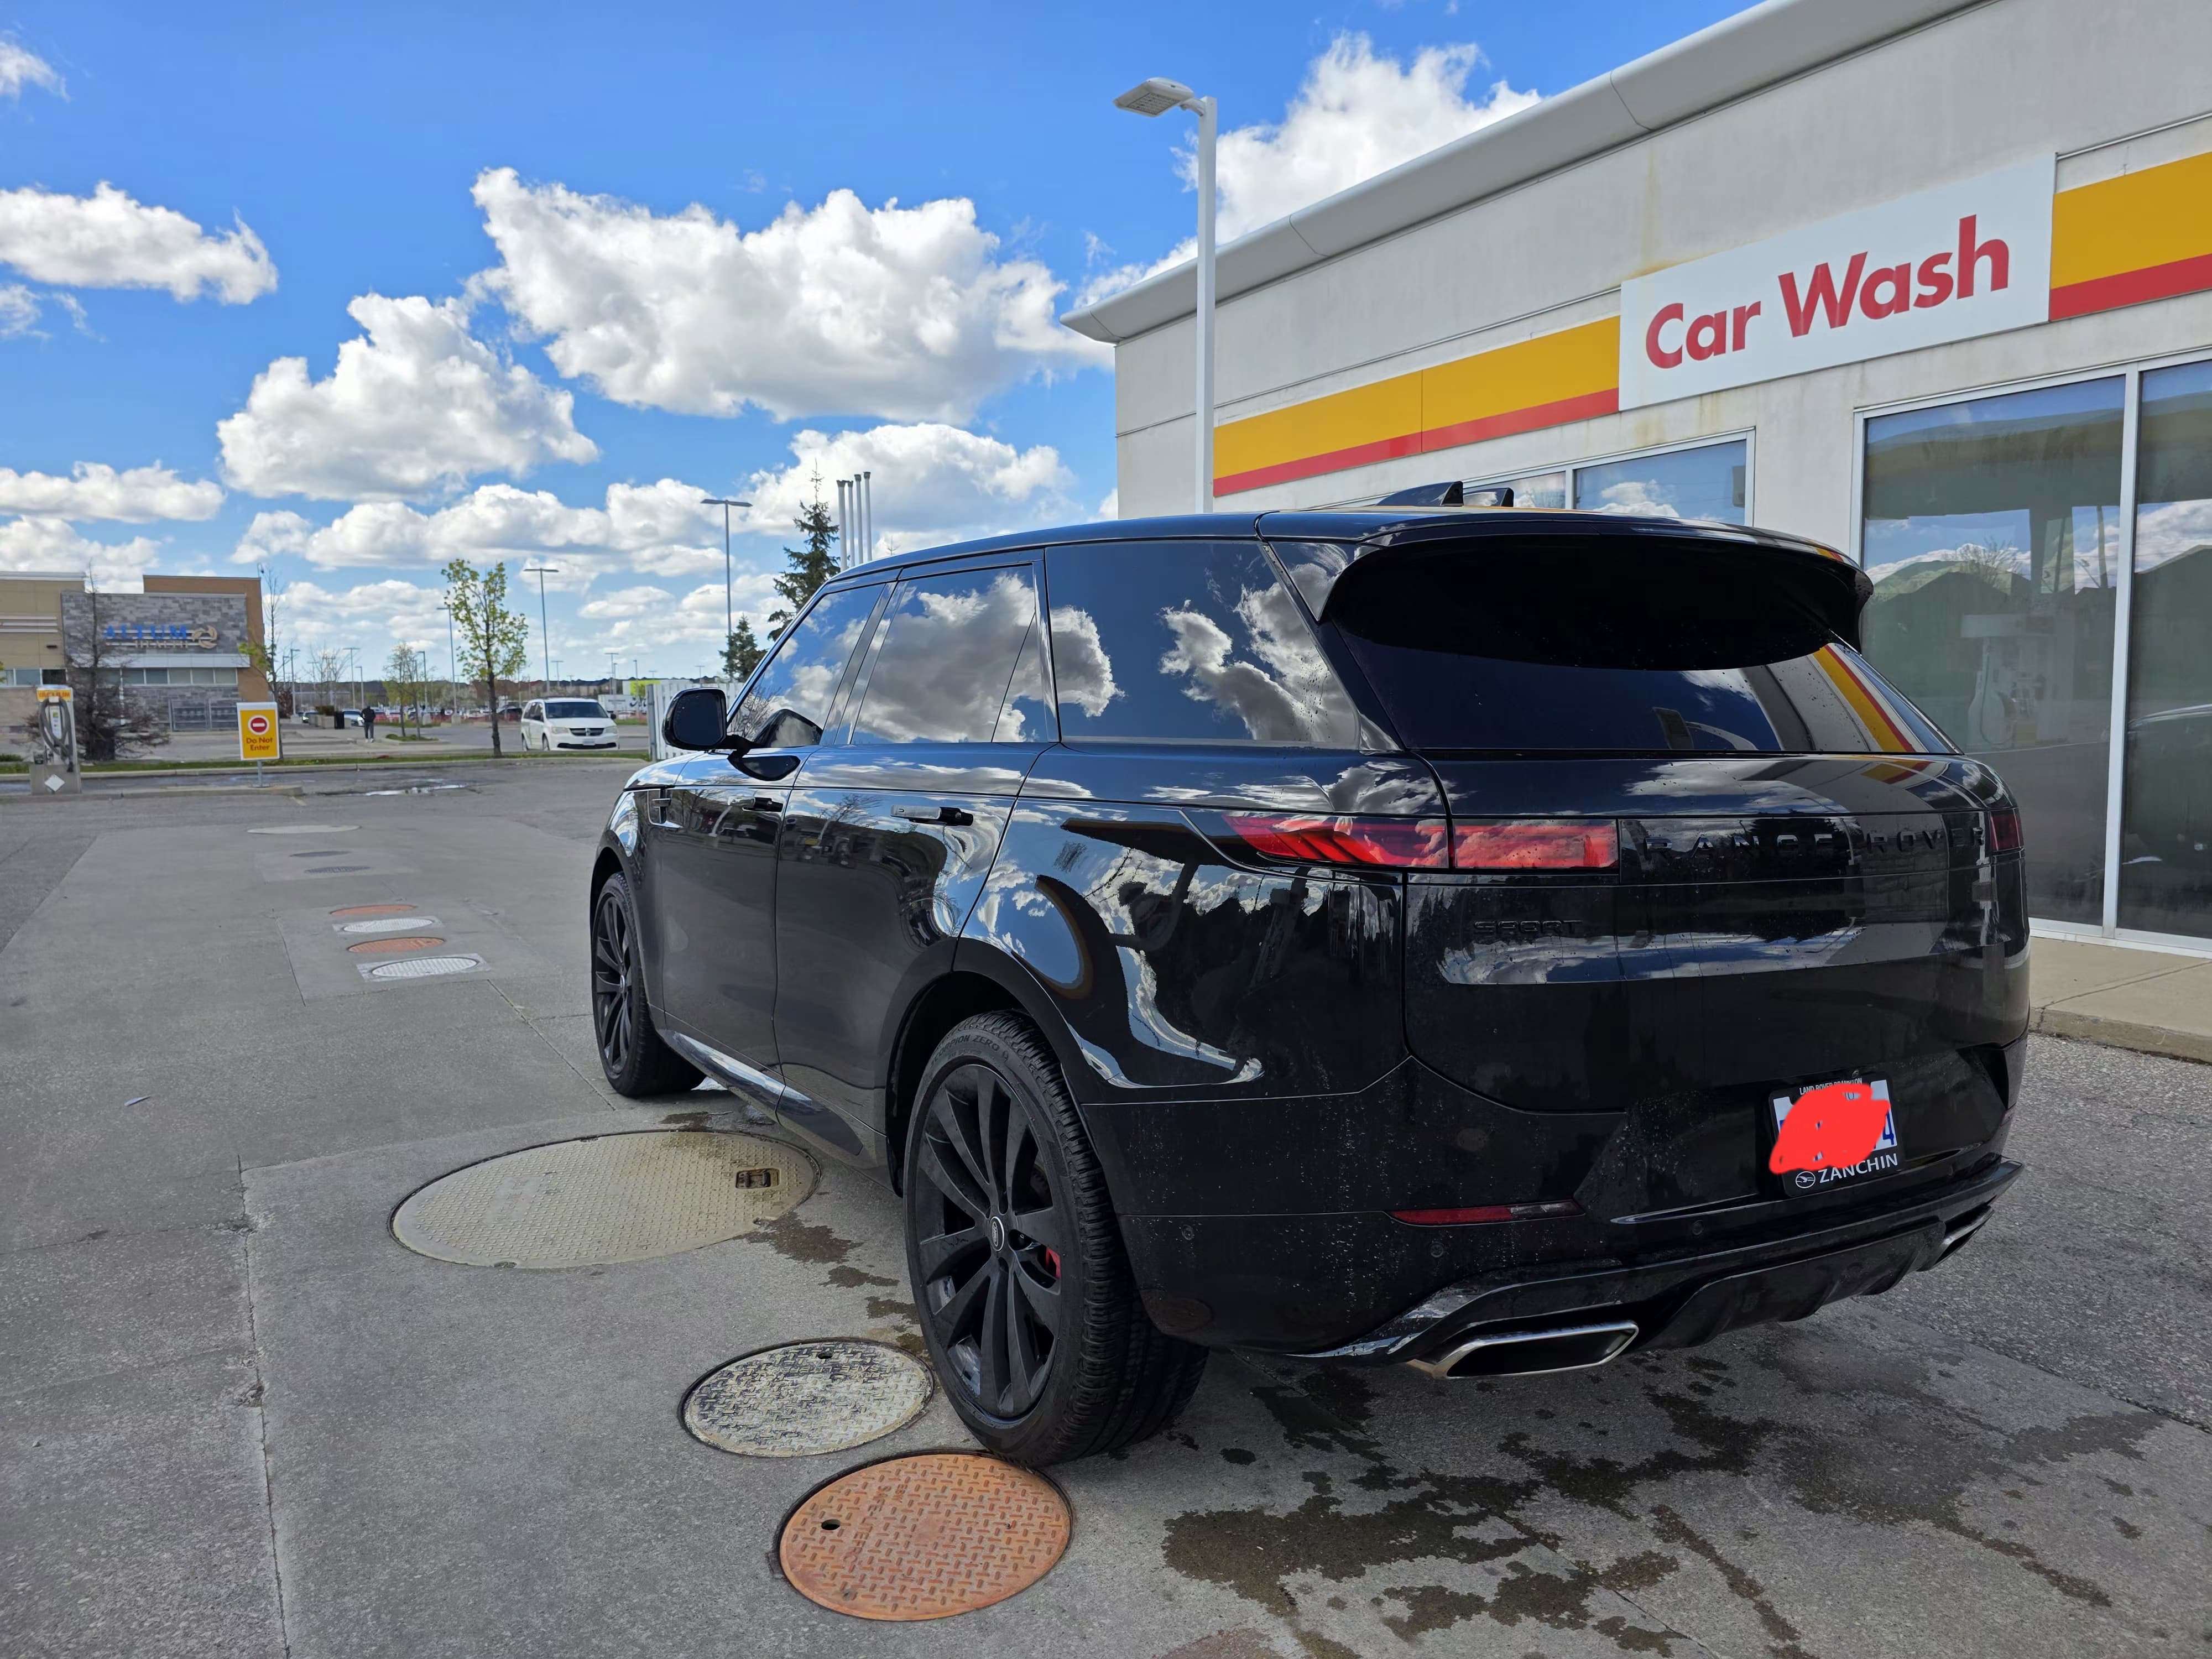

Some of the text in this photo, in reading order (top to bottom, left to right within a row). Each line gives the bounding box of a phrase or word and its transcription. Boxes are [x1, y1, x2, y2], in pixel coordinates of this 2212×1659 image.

[1646, 215, 2009, 369] Car Wash
[1644, 827, 1984, 858] RANGE ROVER
[1474, 920, 1583, 935] SPORT
[972, 1035, 1000, 1051] ZERO
[1818, 1153, 1898, 1183] ZANCHIN
